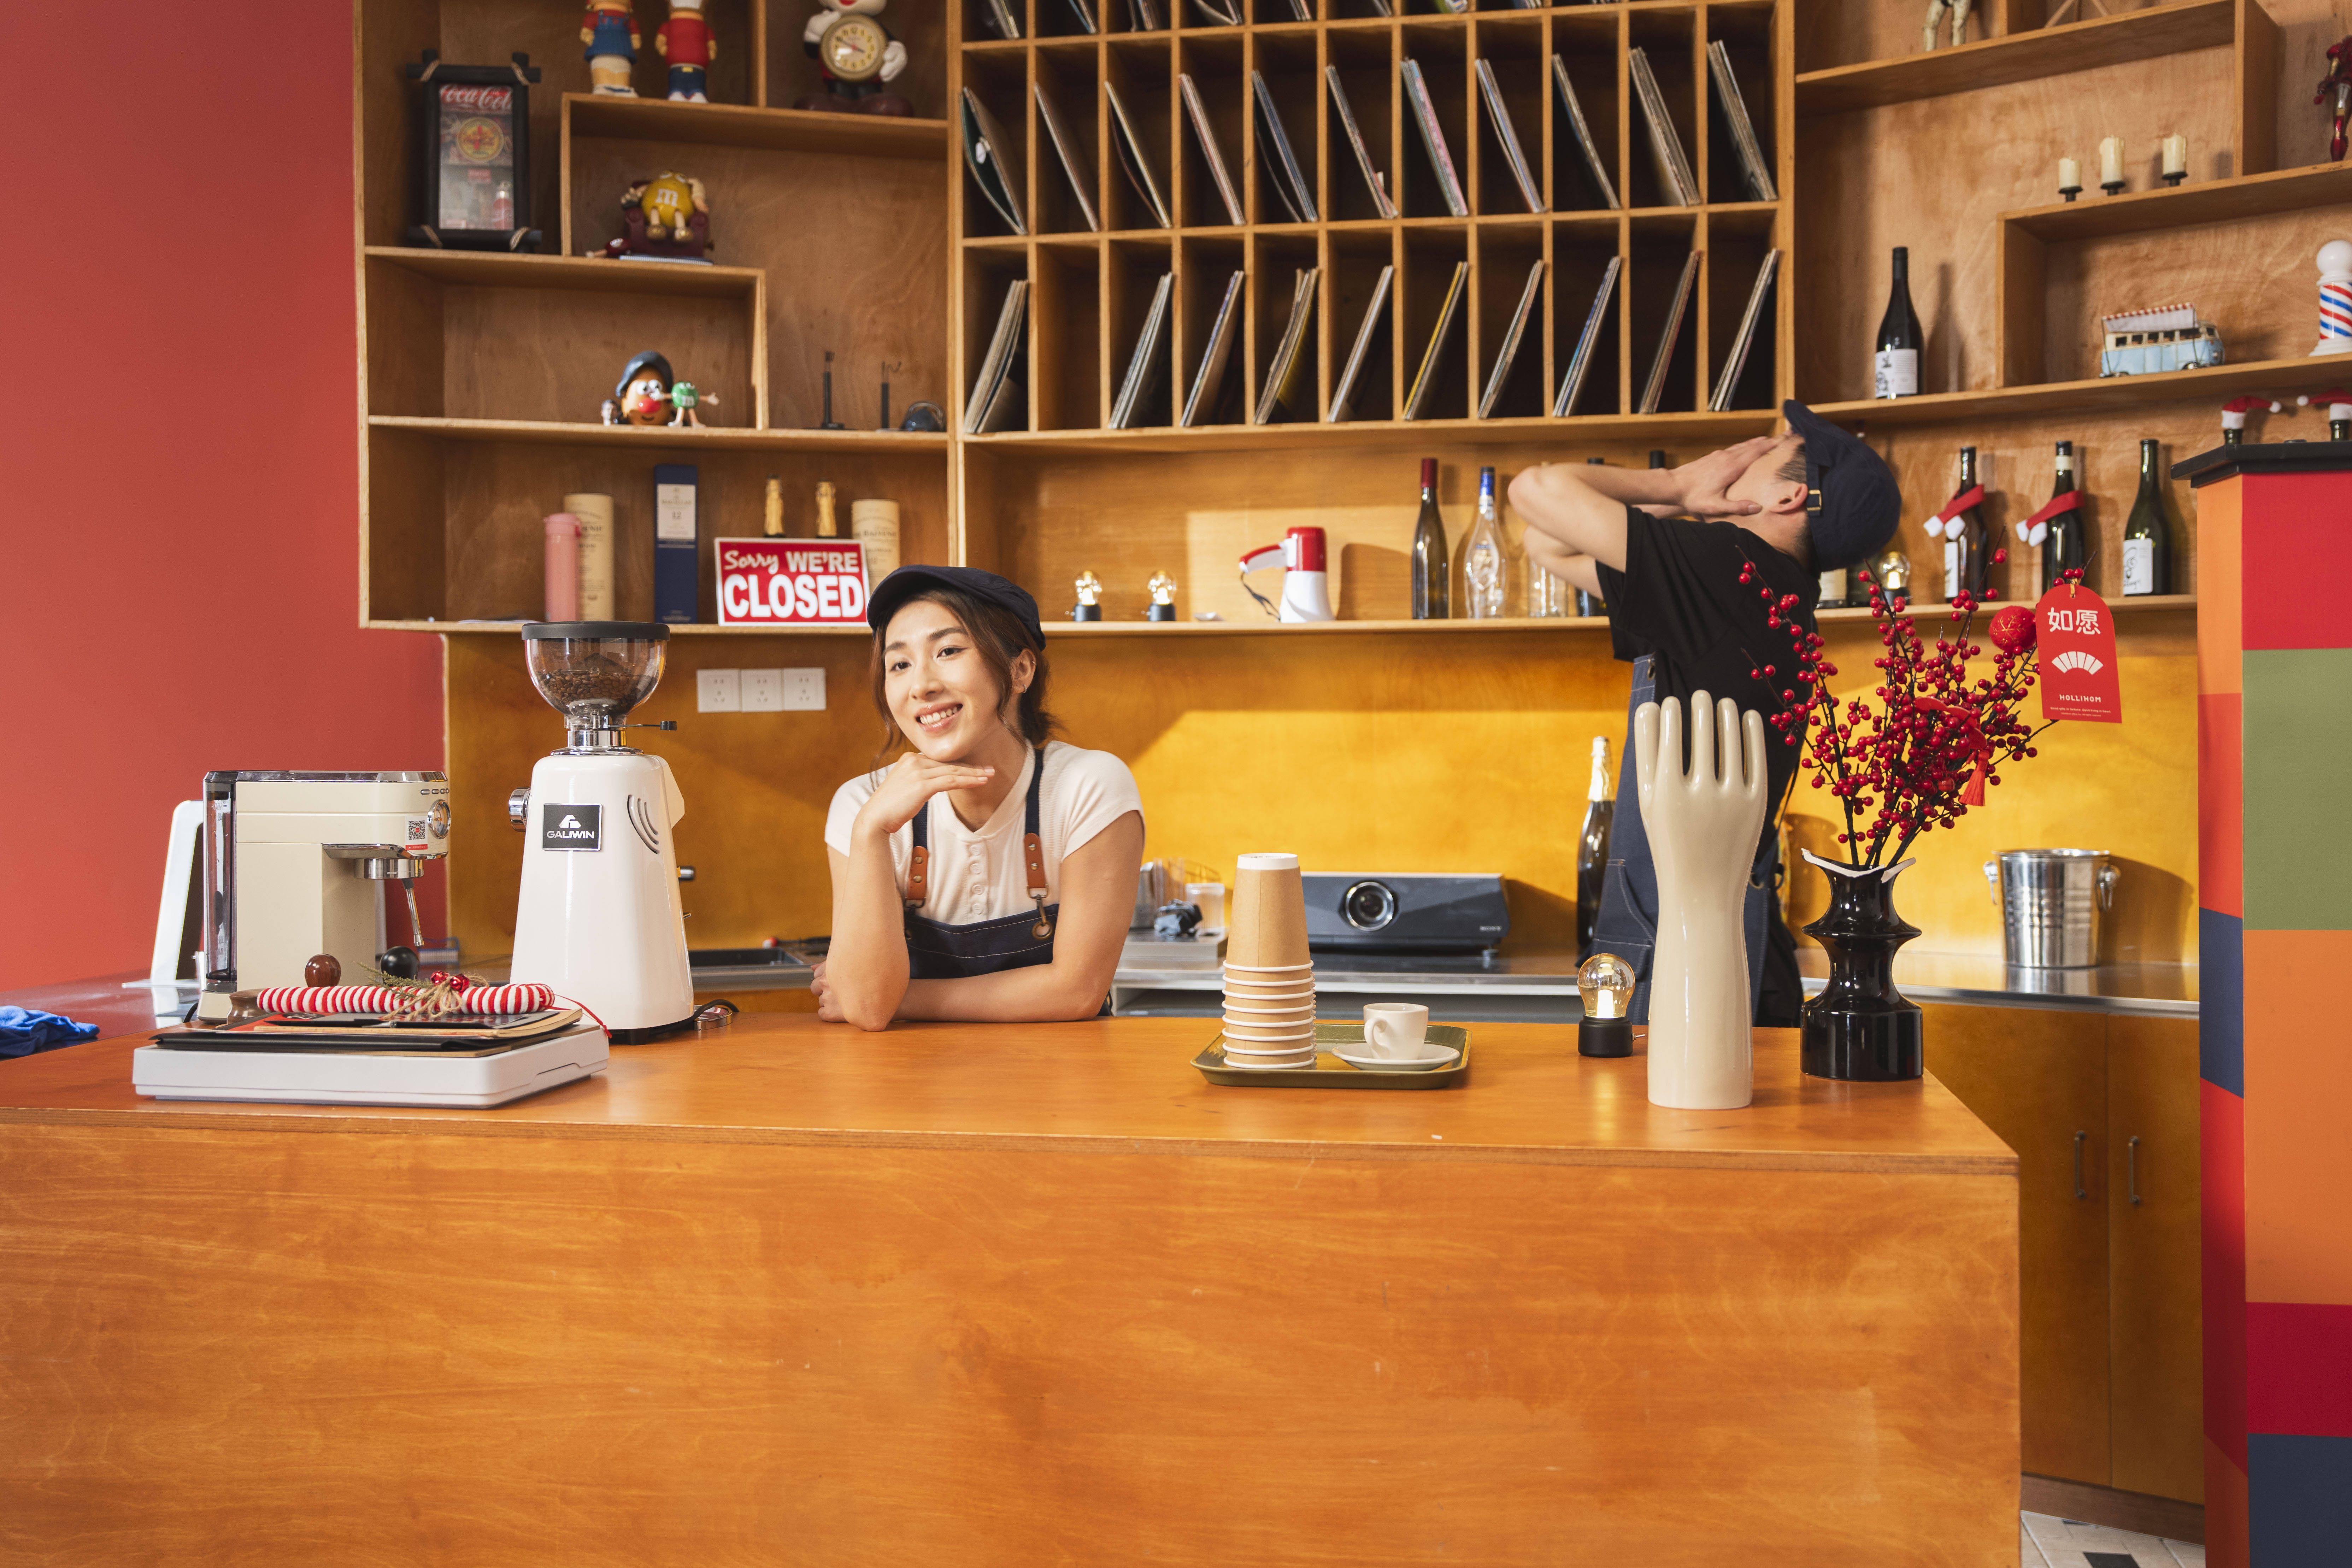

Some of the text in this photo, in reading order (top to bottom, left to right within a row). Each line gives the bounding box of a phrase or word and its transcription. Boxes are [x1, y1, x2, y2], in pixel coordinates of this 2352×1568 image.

[724, 550, 859, 575] Sorry WE'RE
[724, 573, 864, 618] CLOSED
[2047, 607, 2101, 635] 如愿
[2059, 694, 2101, 703] HOLLIHOM
[547, 830, 595, 839] GALIWIN
